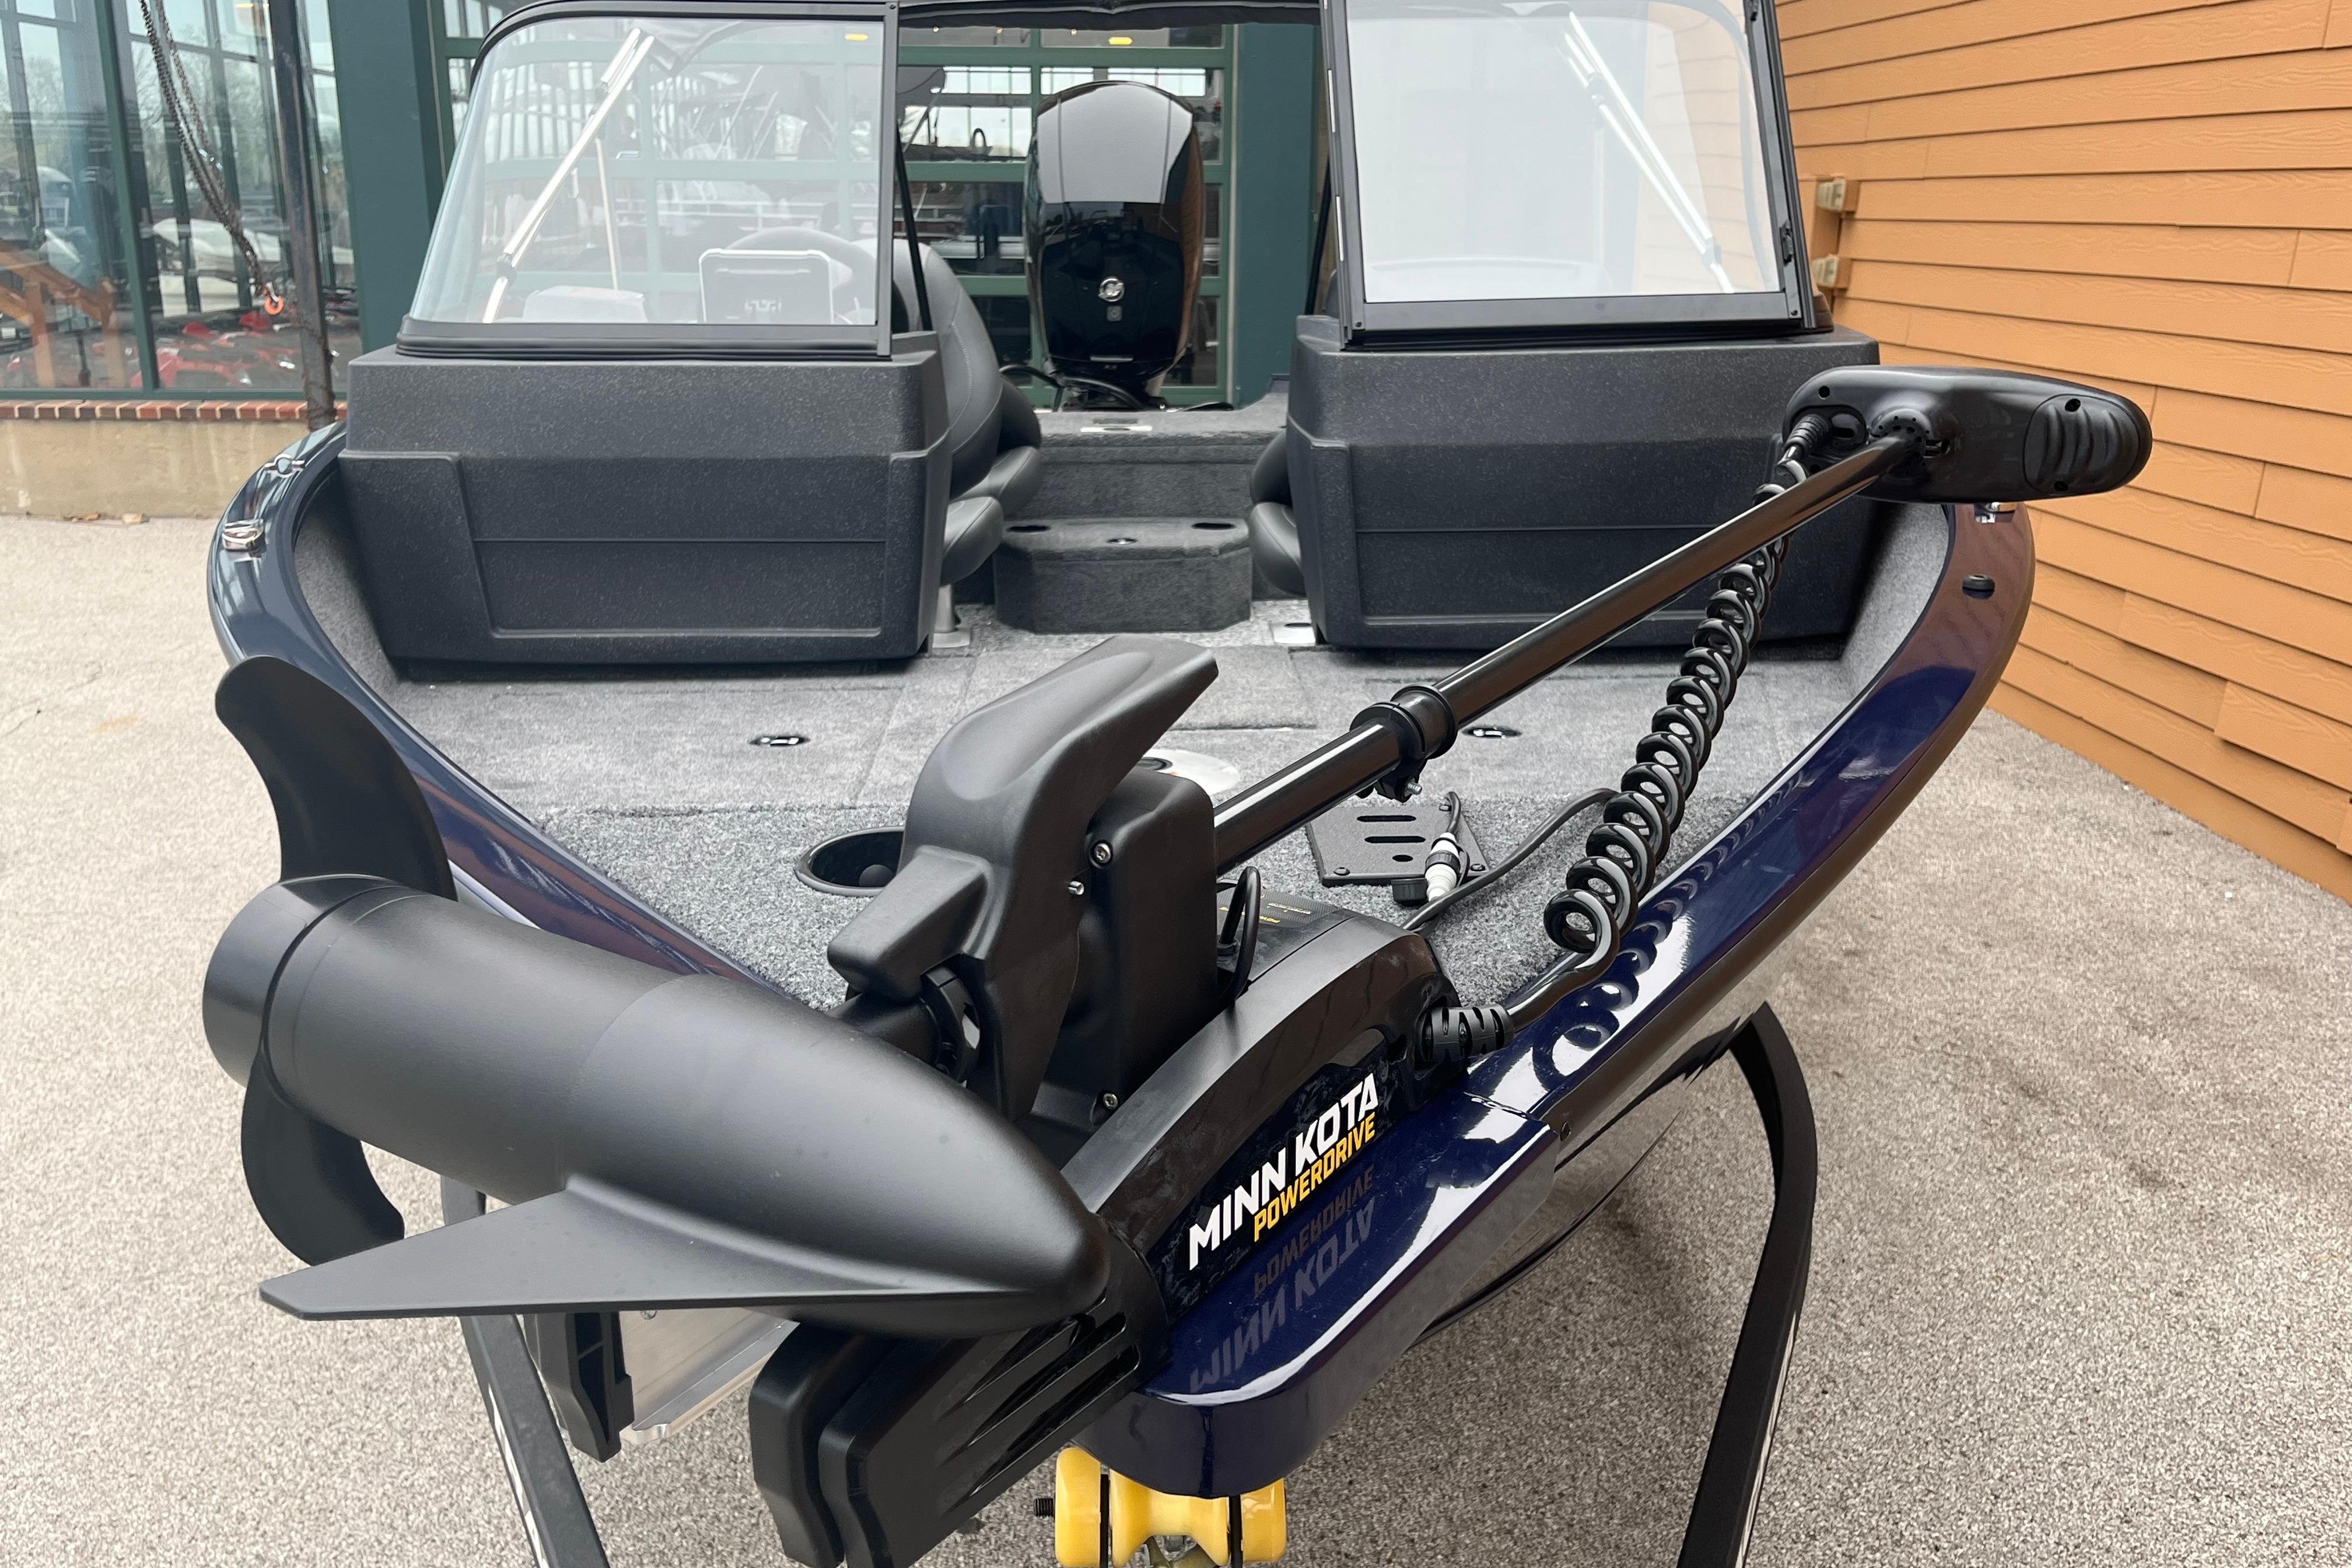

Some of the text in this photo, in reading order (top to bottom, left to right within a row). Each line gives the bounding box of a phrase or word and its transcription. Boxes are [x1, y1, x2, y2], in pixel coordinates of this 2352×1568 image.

[1189, 1073, 1380, 1271] MINN KOTA
[1254, 1111, 1376, 1242] POWERDRIVE
